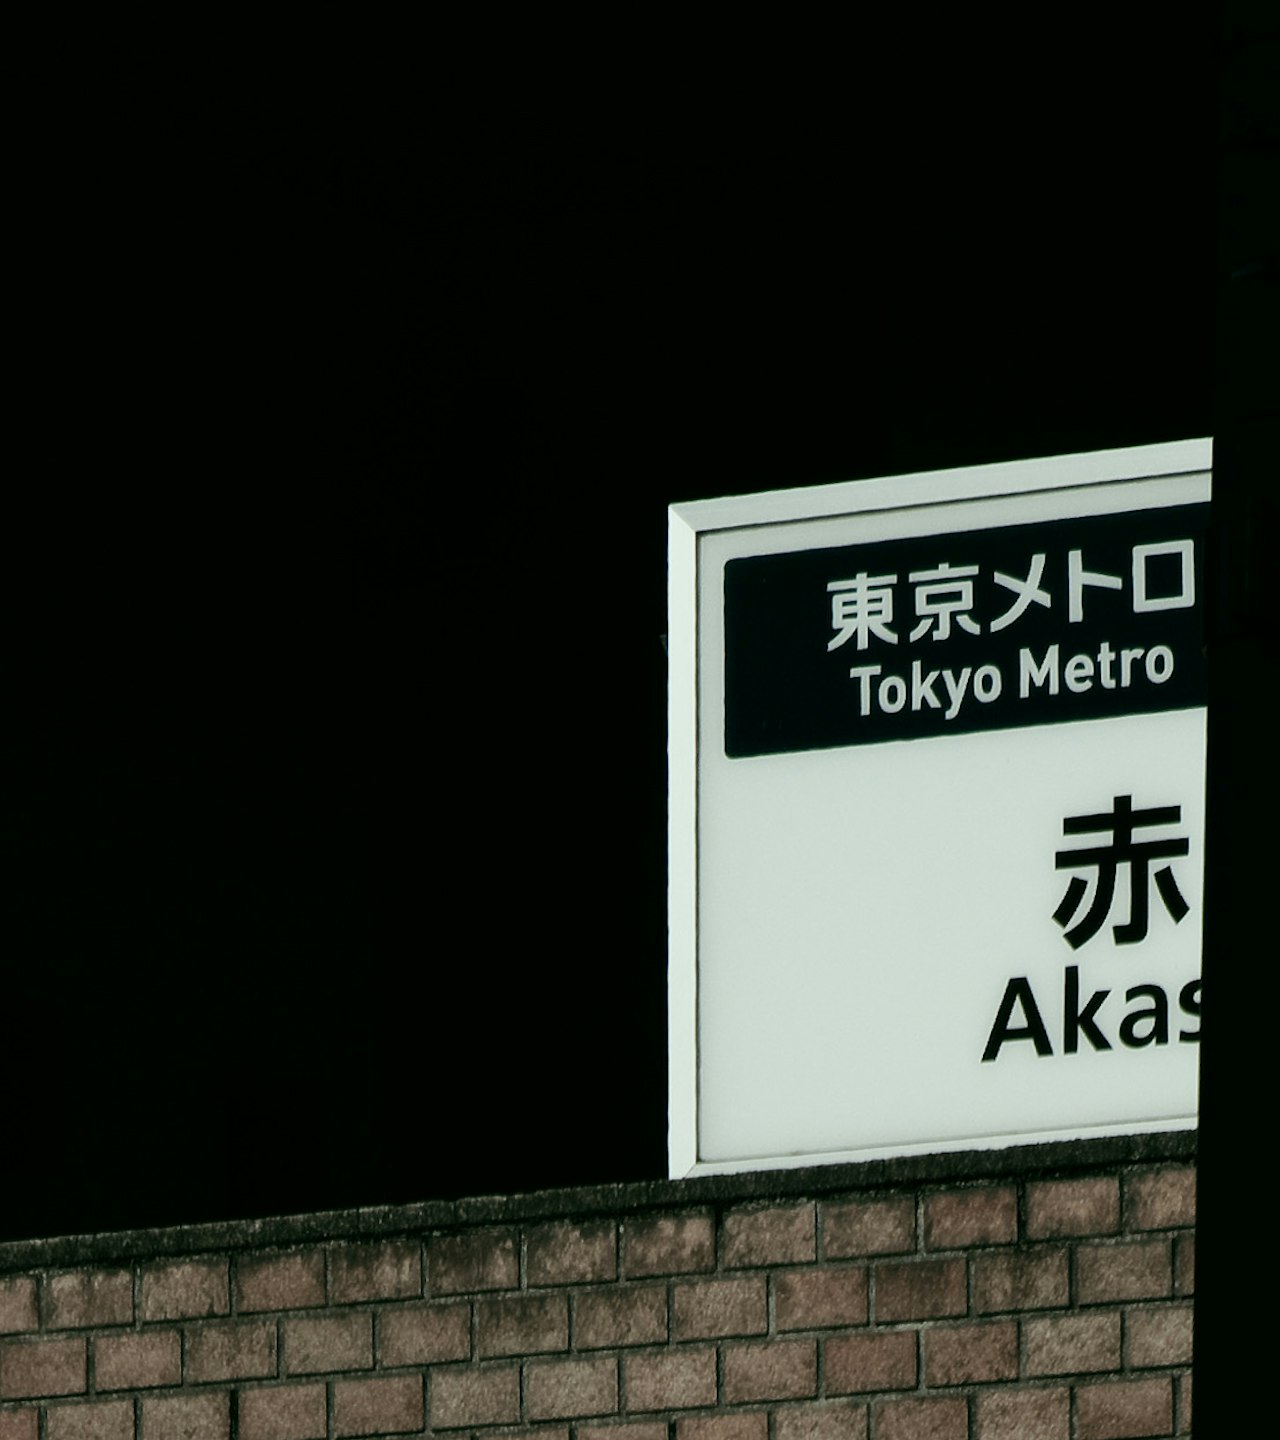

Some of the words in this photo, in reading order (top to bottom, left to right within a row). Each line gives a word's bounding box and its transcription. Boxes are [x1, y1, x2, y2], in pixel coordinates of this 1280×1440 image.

[826, 538, 1195, 653] 東京メトロ
[849, 659, 1003, 721] Tokyo
[1019, 641, 1175, 699] Metro
[1050, 794, 1190, 951] 赤
